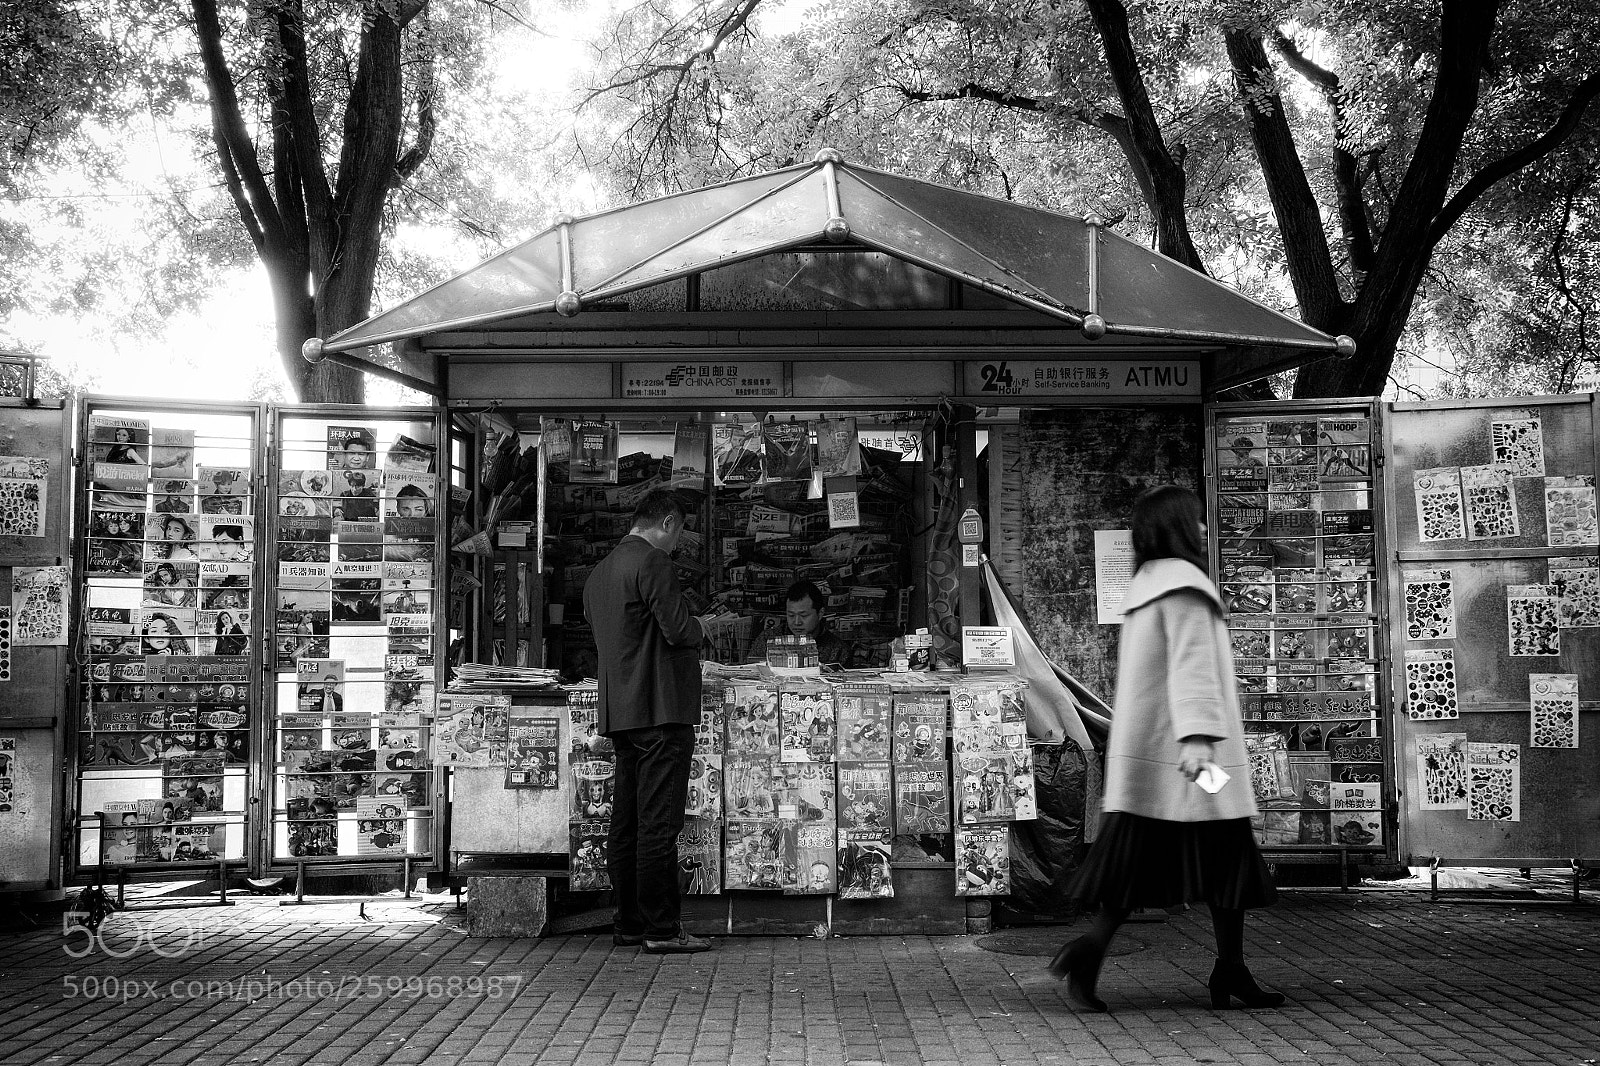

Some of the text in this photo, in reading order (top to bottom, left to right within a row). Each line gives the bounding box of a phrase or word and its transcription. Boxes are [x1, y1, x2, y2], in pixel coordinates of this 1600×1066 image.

[685, 366, 738, 377] 中国邮政
[980, 361, 1014, 392] 24
[1034, 367, 1110, 380] 自助银行服务
[1124, 366, 1188, 387] ATMU
[685, 378, 737, 387] CHINA POST
[1012, 377, 1029, 388] 小时
[1034, 380, 1111, 390] Self-Service Banking
[998, 385, 1022, 395] Hour
[120, 420, 147, 428] WOMEN
[1333, 423, 1358, 431] HOOP
[330, 430, 361, 439] 环球人物
[752, 512, 778, 521] SIZE
[1270, 511, 1315, 528] 看电影
[289, 567, 326, 576] 兵器知识
[343, 565, 372, 573] 航空知识
[1334, 799, 1377, 809] 阶梯数学
